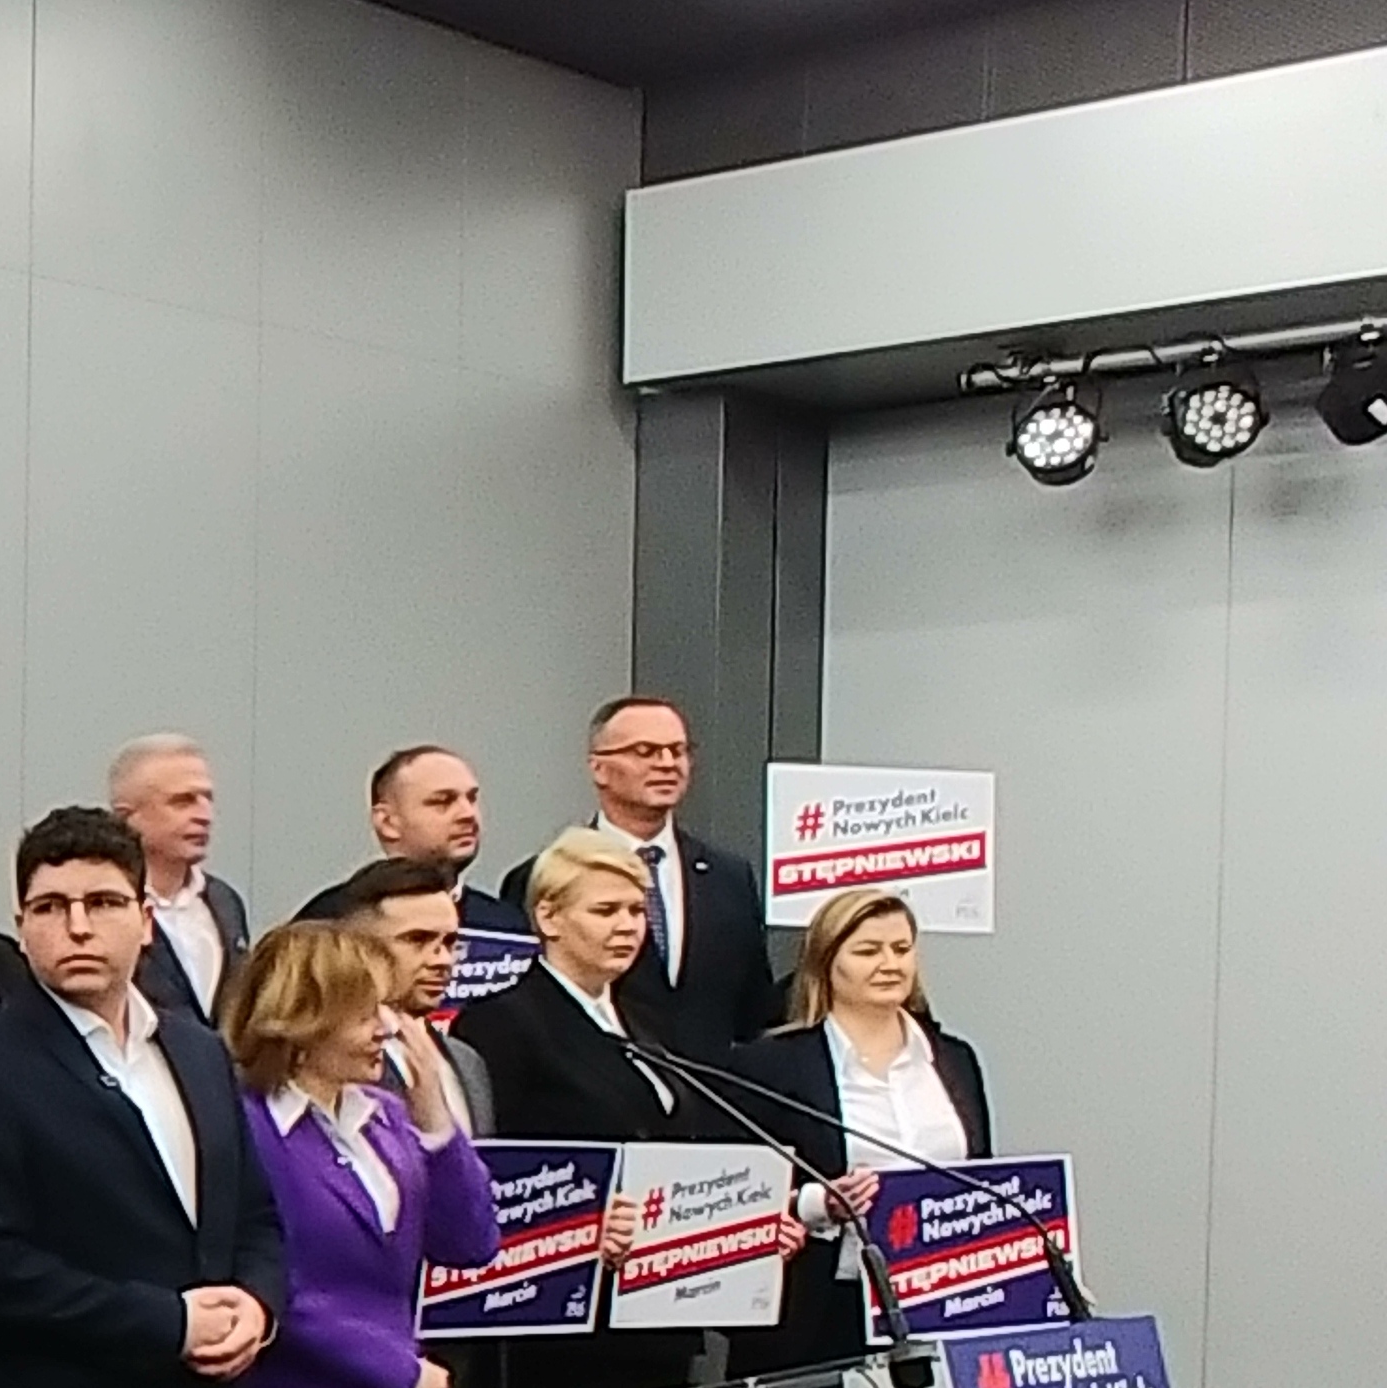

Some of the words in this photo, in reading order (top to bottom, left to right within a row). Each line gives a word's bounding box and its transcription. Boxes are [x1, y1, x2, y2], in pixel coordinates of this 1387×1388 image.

[832, 789, 937, 816] Prezydent
[832, 812, 916, 837] Nowych
[920, 804, 969, 825] Kielc
[778, 839, 981, 884] STĘPNIEWSKI
[671, 1167, 751, 1200] Prezydent
[922, 1203, 1005, 1243] Nowych
[623, 1223, 777, 1280] STĘPNIEWSKI
[943, 1286, 1006, 1318] Marcin
